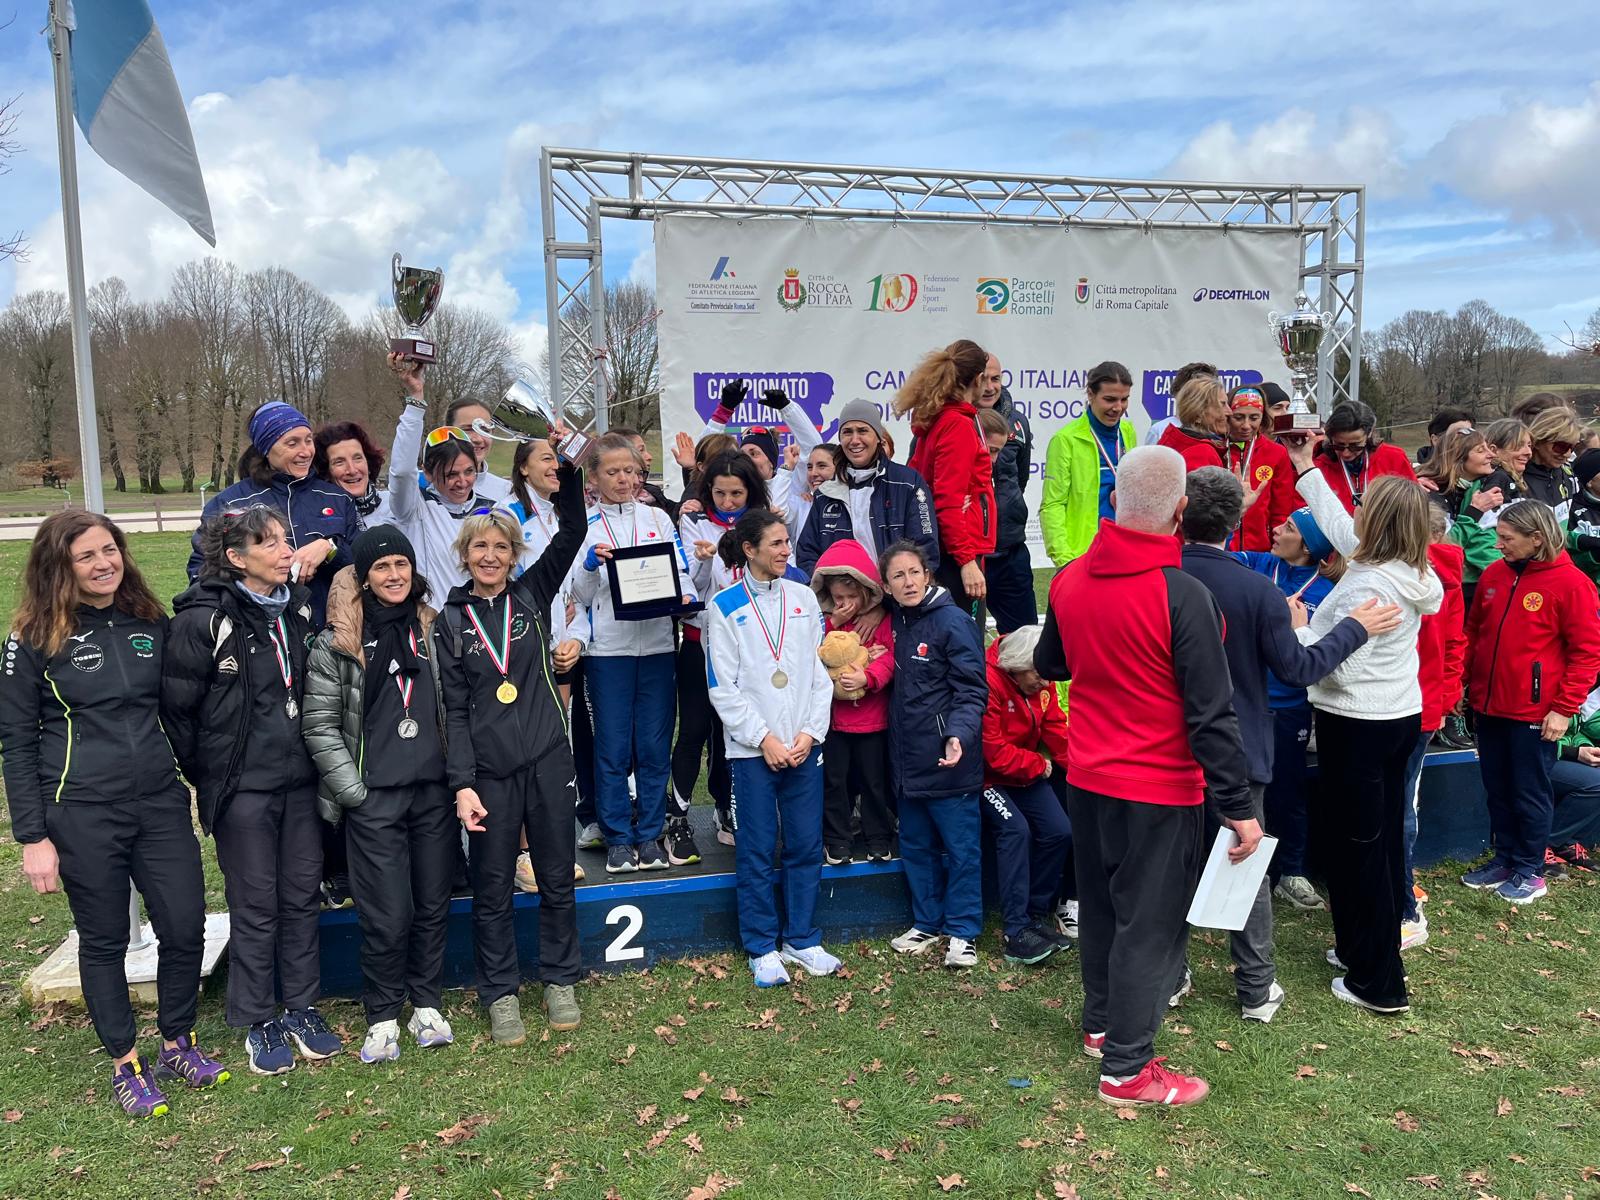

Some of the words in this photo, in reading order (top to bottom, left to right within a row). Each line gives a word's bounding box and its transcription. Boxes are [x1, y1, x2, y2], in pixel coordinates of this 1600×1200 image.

[923, 274, 960, 282] Federazione
[1011, 277, 1043, 290] Parco
[1043, 279, 1056, 288] dei
[808, 281, 849, 294] ROCCA
[923, 284, 946, 293] Italiana
[1095, 284, 1117, 295] Città
[1119, 284, 1177, 297] metropolitana
[808, 294, 820, 305] DI
[825, 293, 853, 305] PAPA
[922, 295, 940, 304] Sport
[1011, 289, 1055, 305] Castelli
[1208, 289, 1270, 301] DECATHLON
[922, 305, 948, 314] Equestri
[1011, 302, 1053, 315] Romani
[1094, 299, 1104, 309] di
[1106, 299, 1132, 310] Roma
[1134, 299, 1169, 312] Capitale
[707, 378, 809, 399] CAPIONATO
[605, 904, 644, 963] 2
